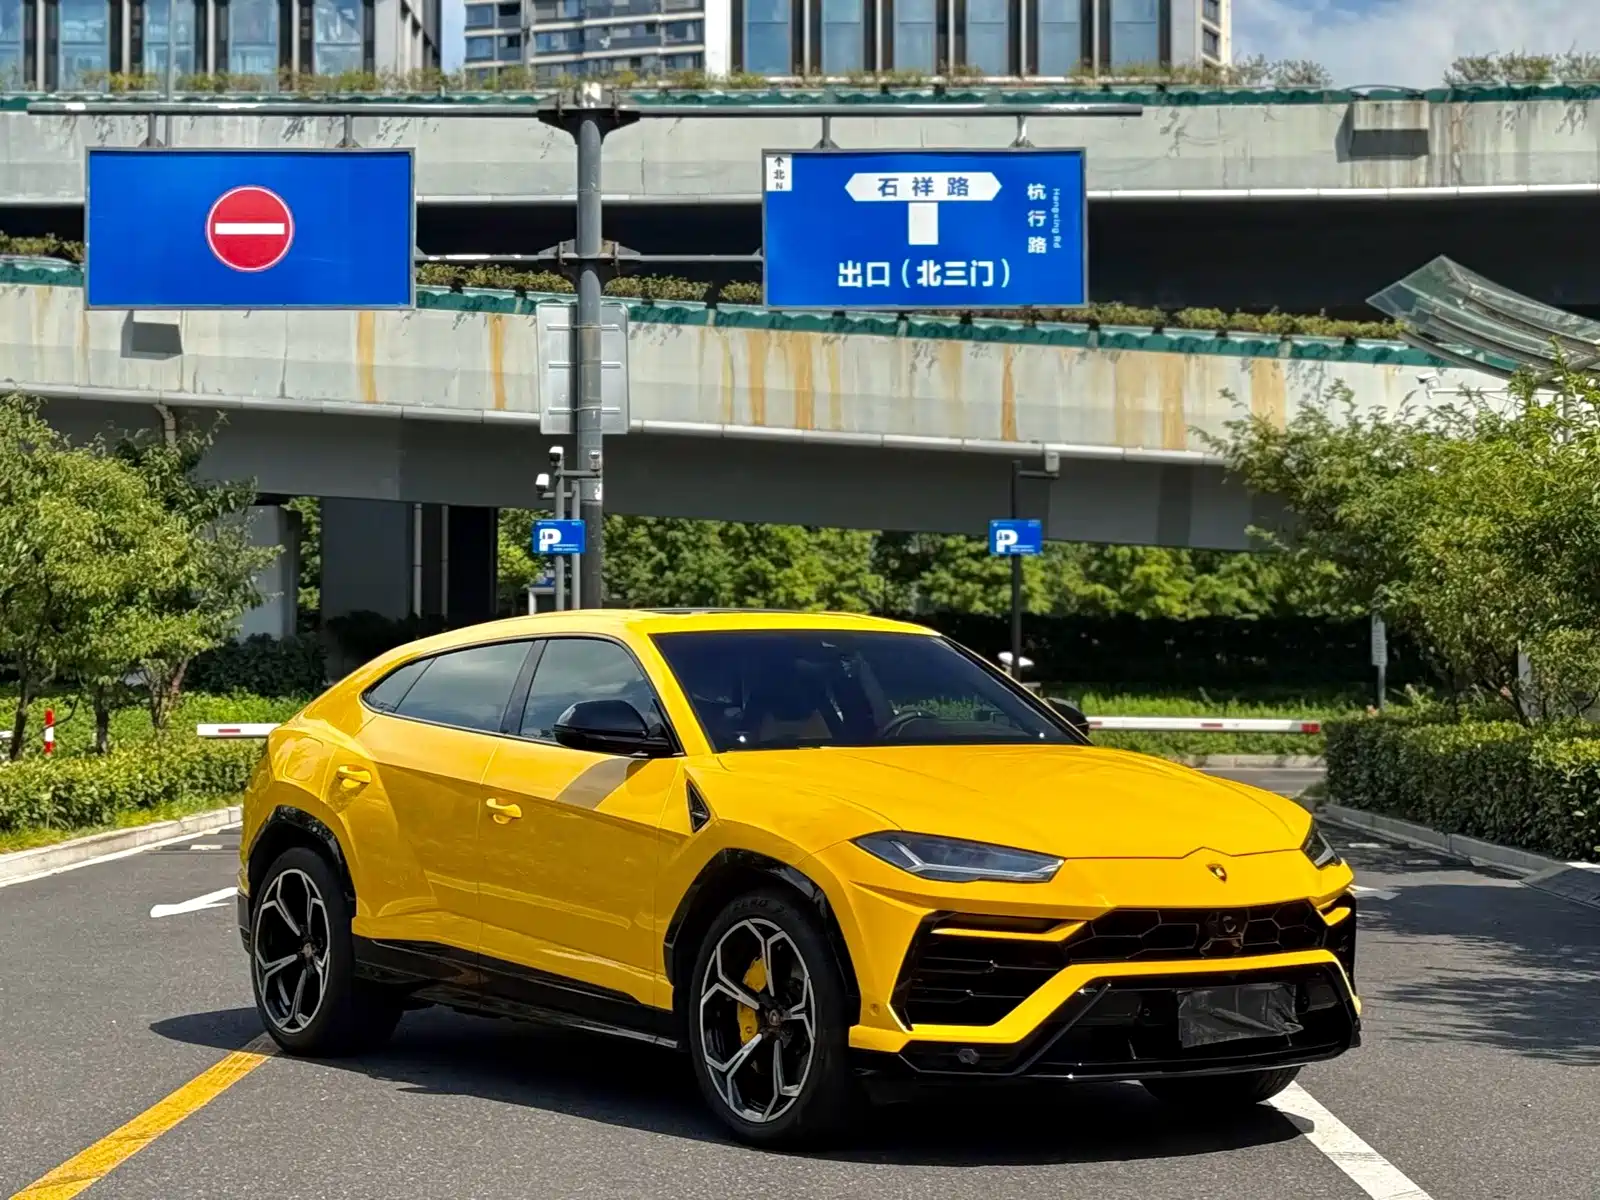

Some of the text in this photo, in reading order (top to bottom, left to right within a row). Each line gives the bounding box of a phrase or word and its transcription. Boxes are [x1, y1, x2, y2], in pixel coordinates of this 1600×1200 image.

[774, 169, 785, 180] 北
[775, 182, 784, 190] N
[877, 176, 970, 197] 石祥路
[1027, 183, 1047, 254] 杭行路
[1053, 235, 1062, 249] Rd
[539, 528, 562, 552] P
[996, 529, 1018, 553] P
